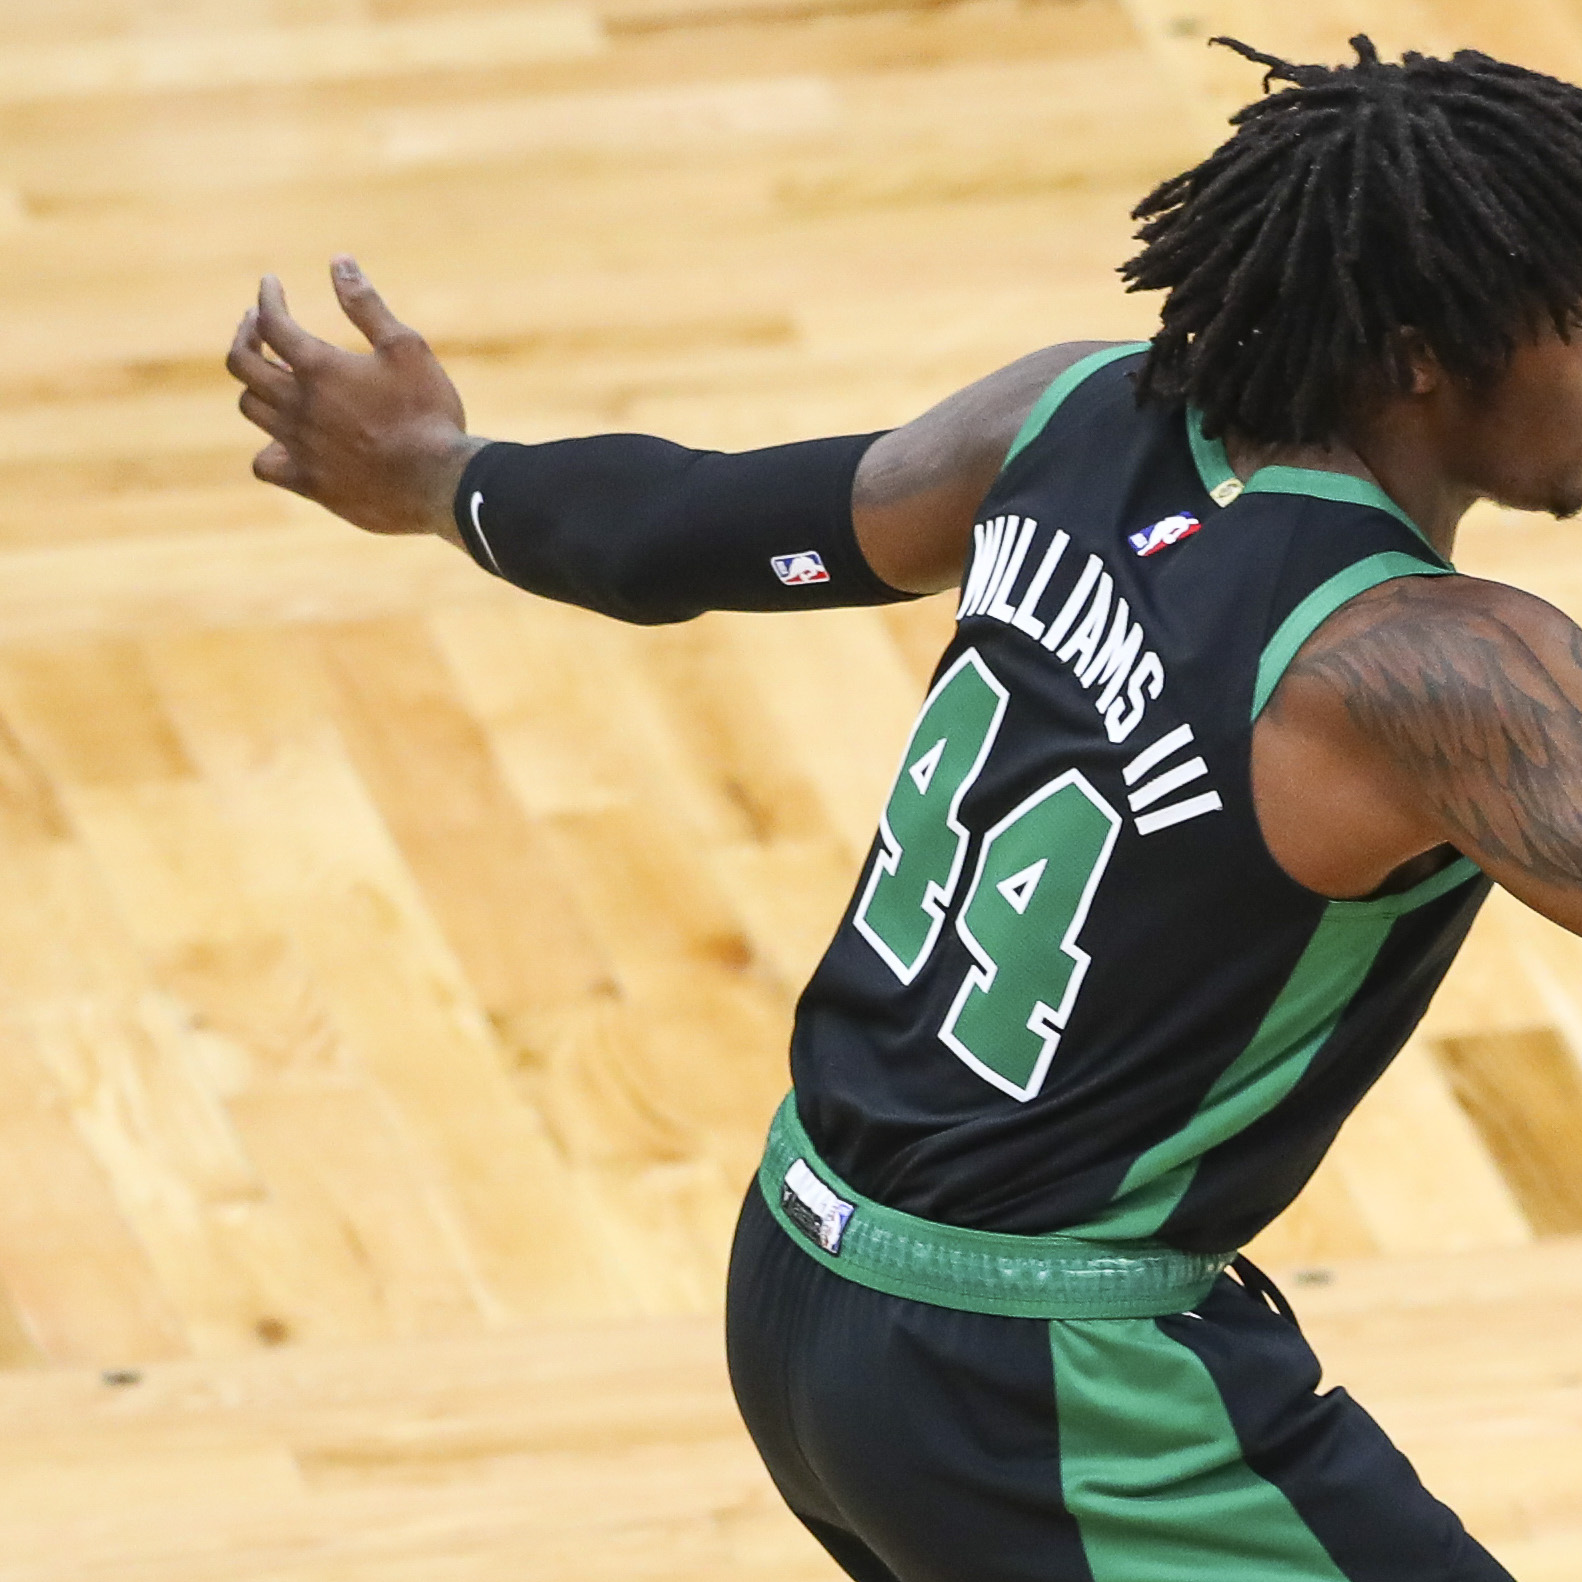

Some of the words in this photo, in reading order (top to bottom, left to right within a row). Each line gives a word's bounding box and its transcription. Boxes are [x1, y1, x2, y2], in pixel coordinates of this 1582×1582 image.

[956, 515, 1165, 744] WILLIAMS
[1122, 723, 1225, 836] III
[853, 646, 1123, 1103] 44
